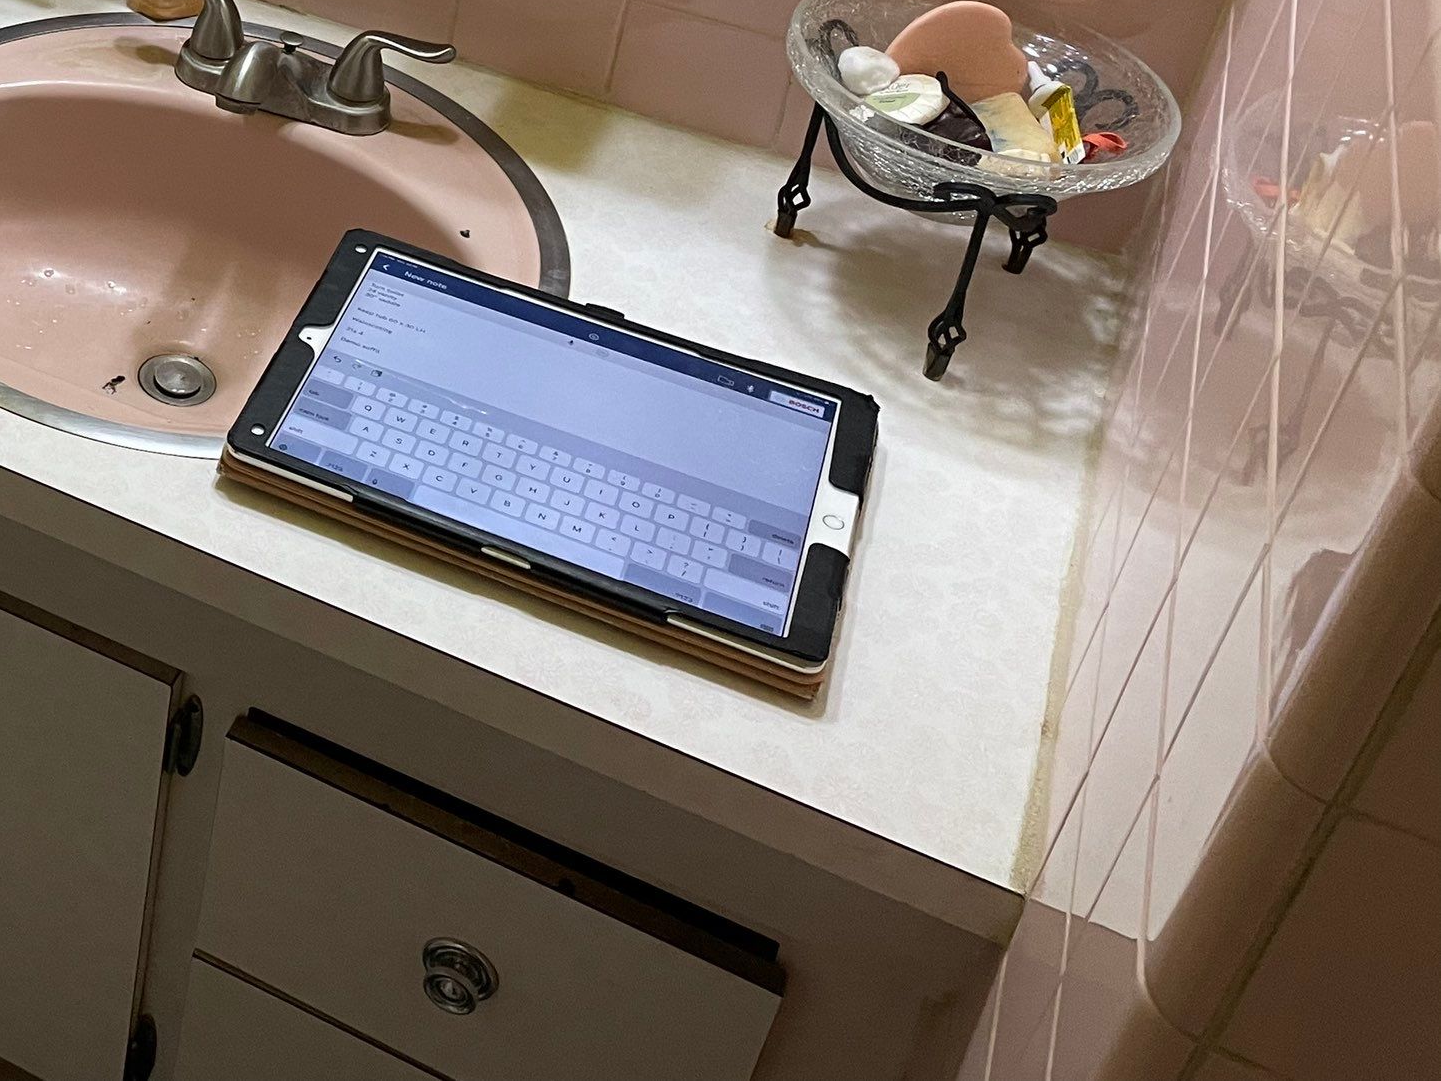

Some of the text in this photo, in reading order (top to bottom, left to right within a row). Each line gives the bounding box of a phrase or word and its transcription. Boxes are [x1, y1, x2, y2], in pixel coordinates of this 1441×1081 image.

[404, 271, 448, 290] New note
[788, 399, 820, 413] BOSCH
